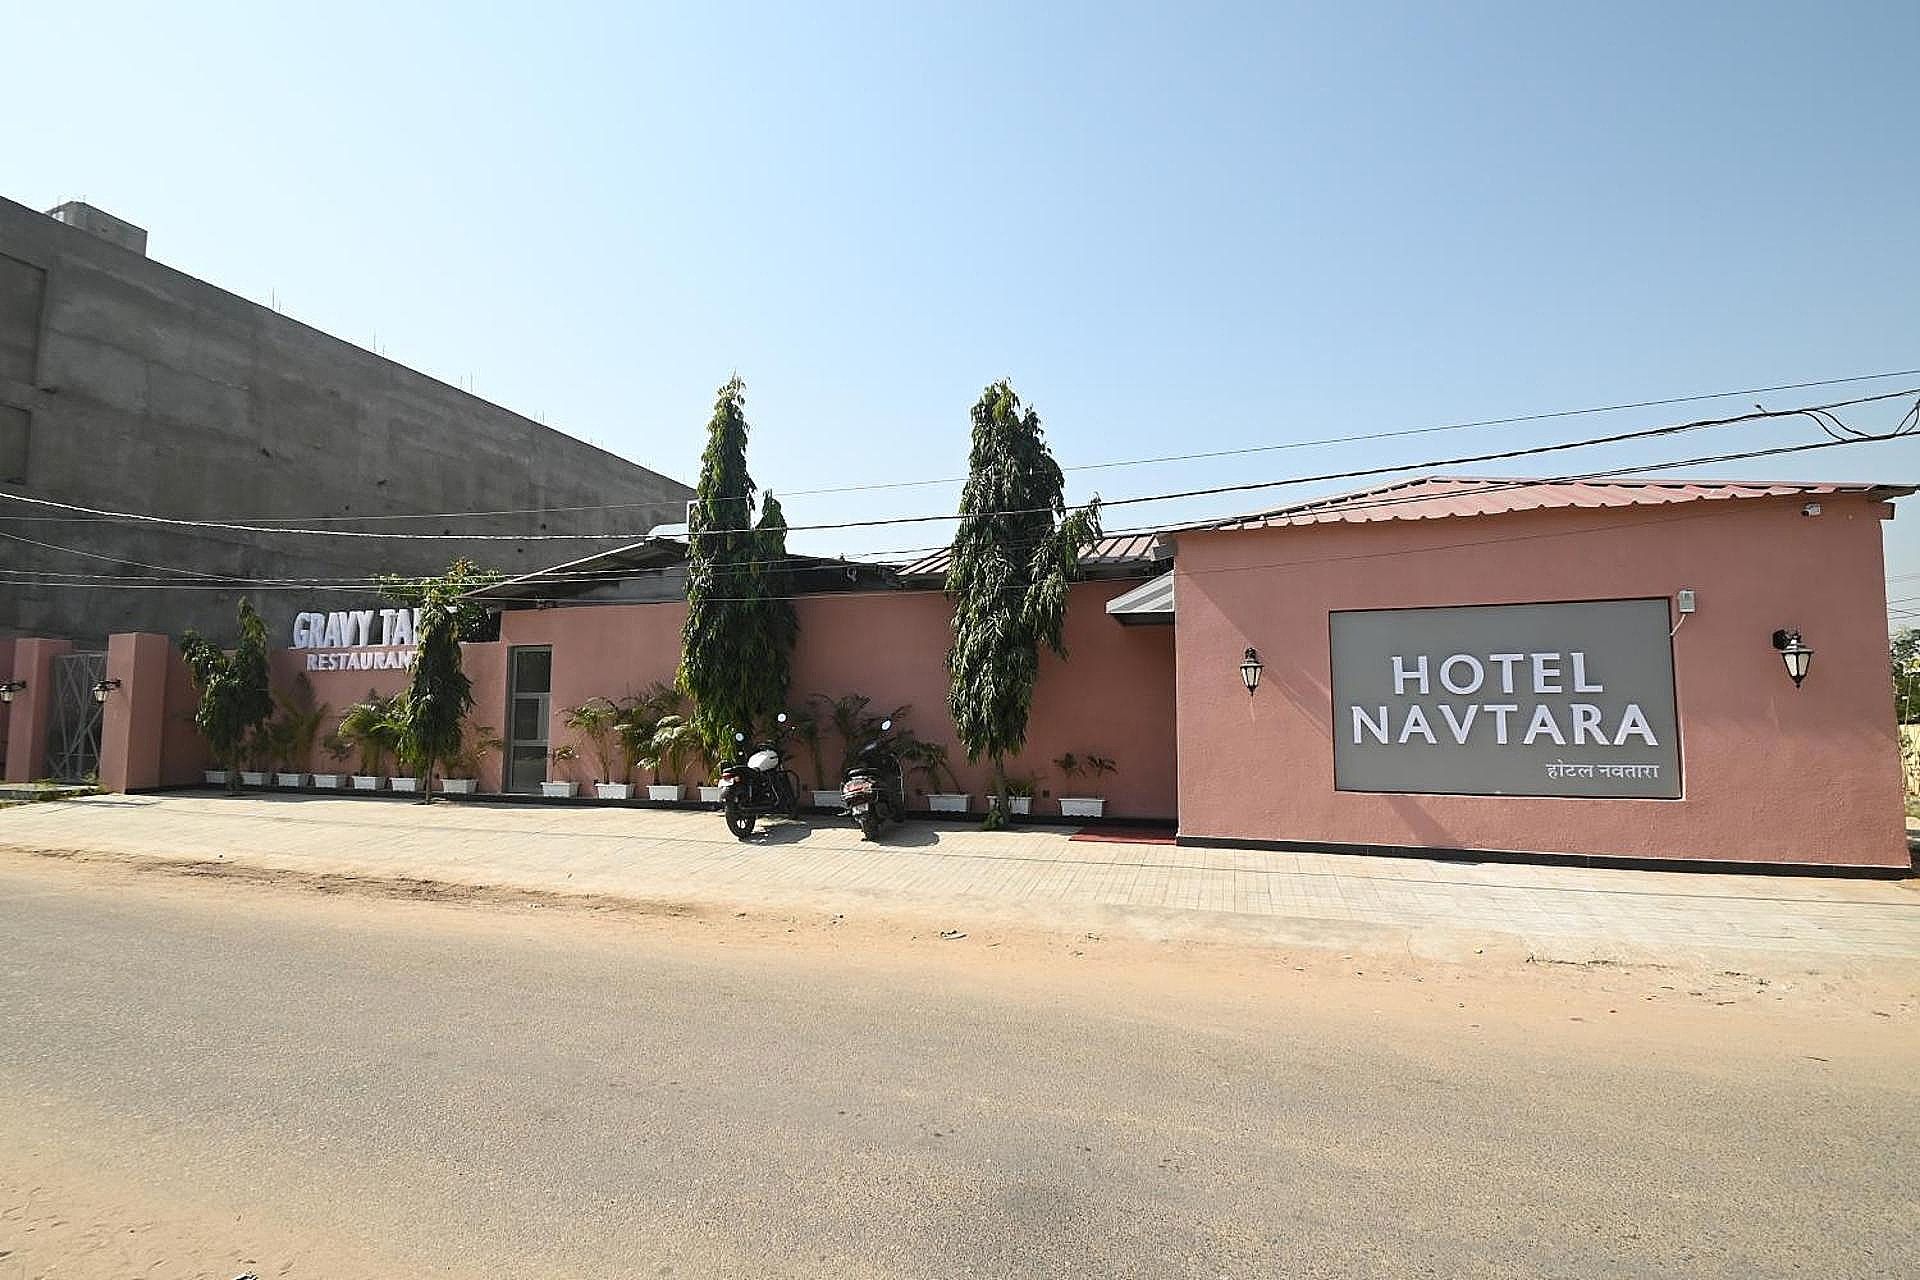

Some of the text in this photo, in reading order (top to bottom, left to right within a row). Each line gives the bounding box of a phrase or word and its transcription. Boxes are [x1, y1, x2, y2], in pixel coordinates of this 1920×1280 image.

[294, 610, 374, 648] GRAVY
[306, 651, 418, 671] RESTAURAN
[1391, 652, 1603, 695] HOTEL
[1351, 703, 1659, 746] NAVTARA
[1545, 759, 1660, 779] होटल नवतारा
